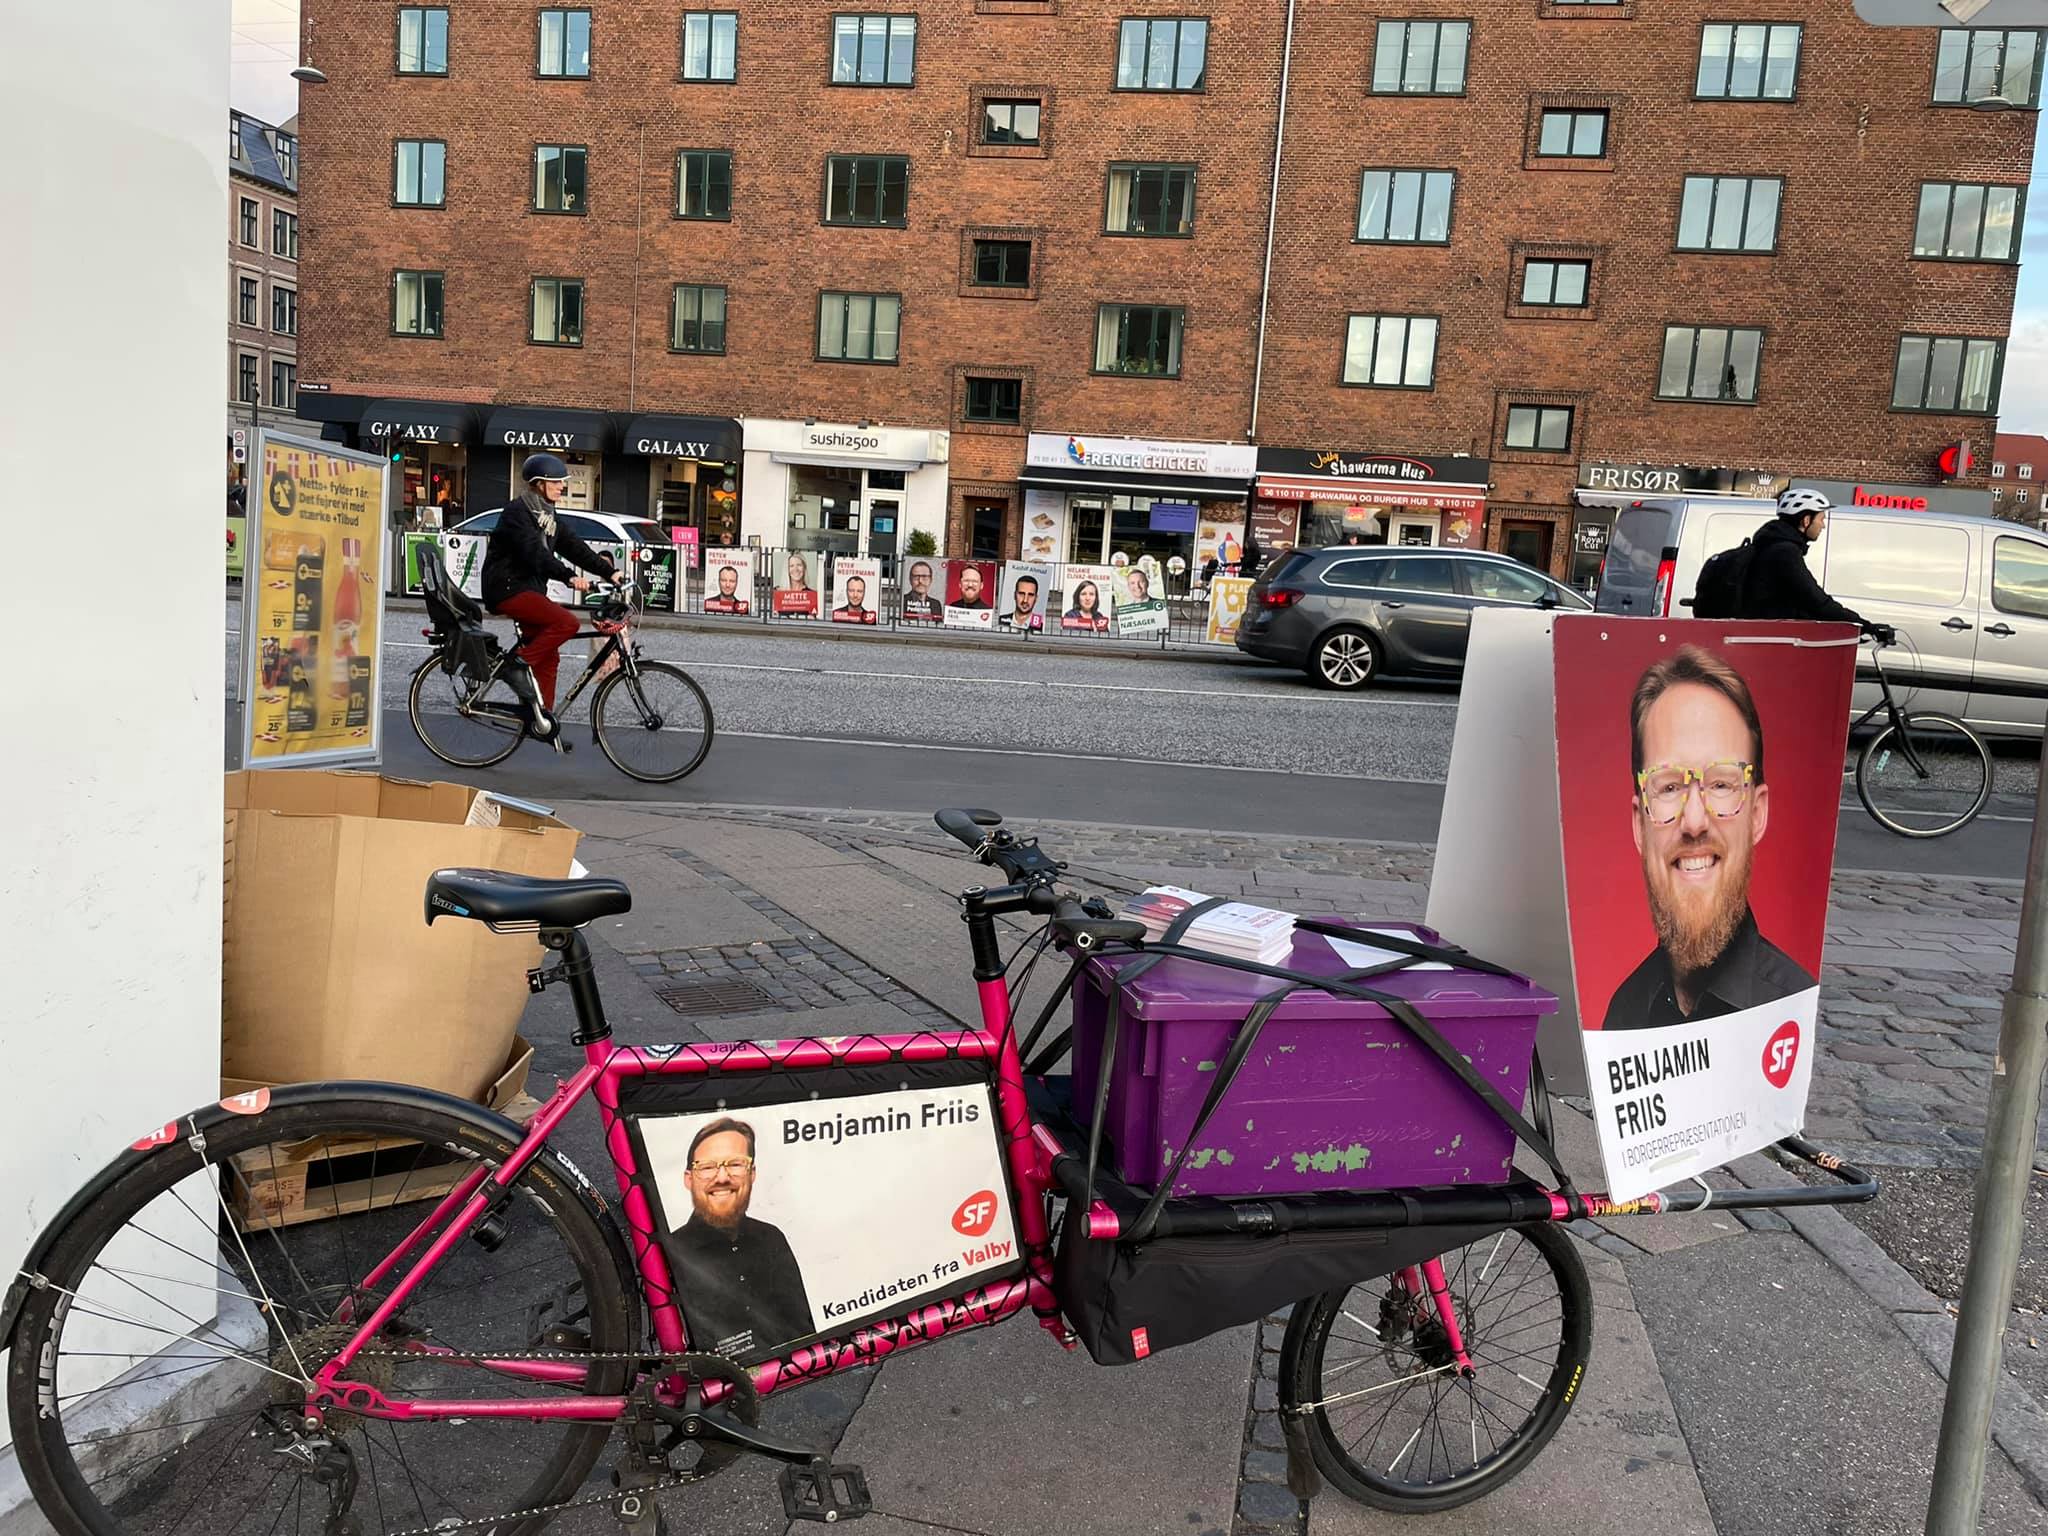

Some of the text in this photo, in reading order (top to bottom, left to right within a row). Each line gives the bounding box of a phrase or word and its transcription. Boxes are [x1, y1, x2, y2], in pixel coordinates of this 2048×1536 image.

[504, 430, 574, 447] GALAXY
[638, 439, 710, 456] GALAXY
[810, 433, 878, 450] sushi2500
[1083, 453, 1208, 472] FRENCH CHICKEN
[1330, 460, 1425, 480] Shawarma Hus
[1588, 467, 1680, 491] FRISØR
[1310, 492, 1358, 501] SHAWARMA
[1374, 496, 1409, 505] BURGER
[1854, 485, 1928, 512] home
[1581, 536, 1604, 545] Royal
[1033, 616, 1039, 625] B
[1120, 618, 1155, 629] NÆSAGER
[1608, 1038, 1710, 1094] BENJAMIN
[1769, 1036, 1795, 1074] SF
[783, 1099, 980, 1146] Benjamin Friis
[1614, 1092, 1666, 1139] FRIIS
[1627, 1111, 1747, 1167] BORGERREPRÆSENTATIONEN
[962, 1200, 991, 1228] SF
[822, 1240, 1012, 1319] Kandidaten fra Valby
[1564, 1365, 1582, 1402] MAXXIS
